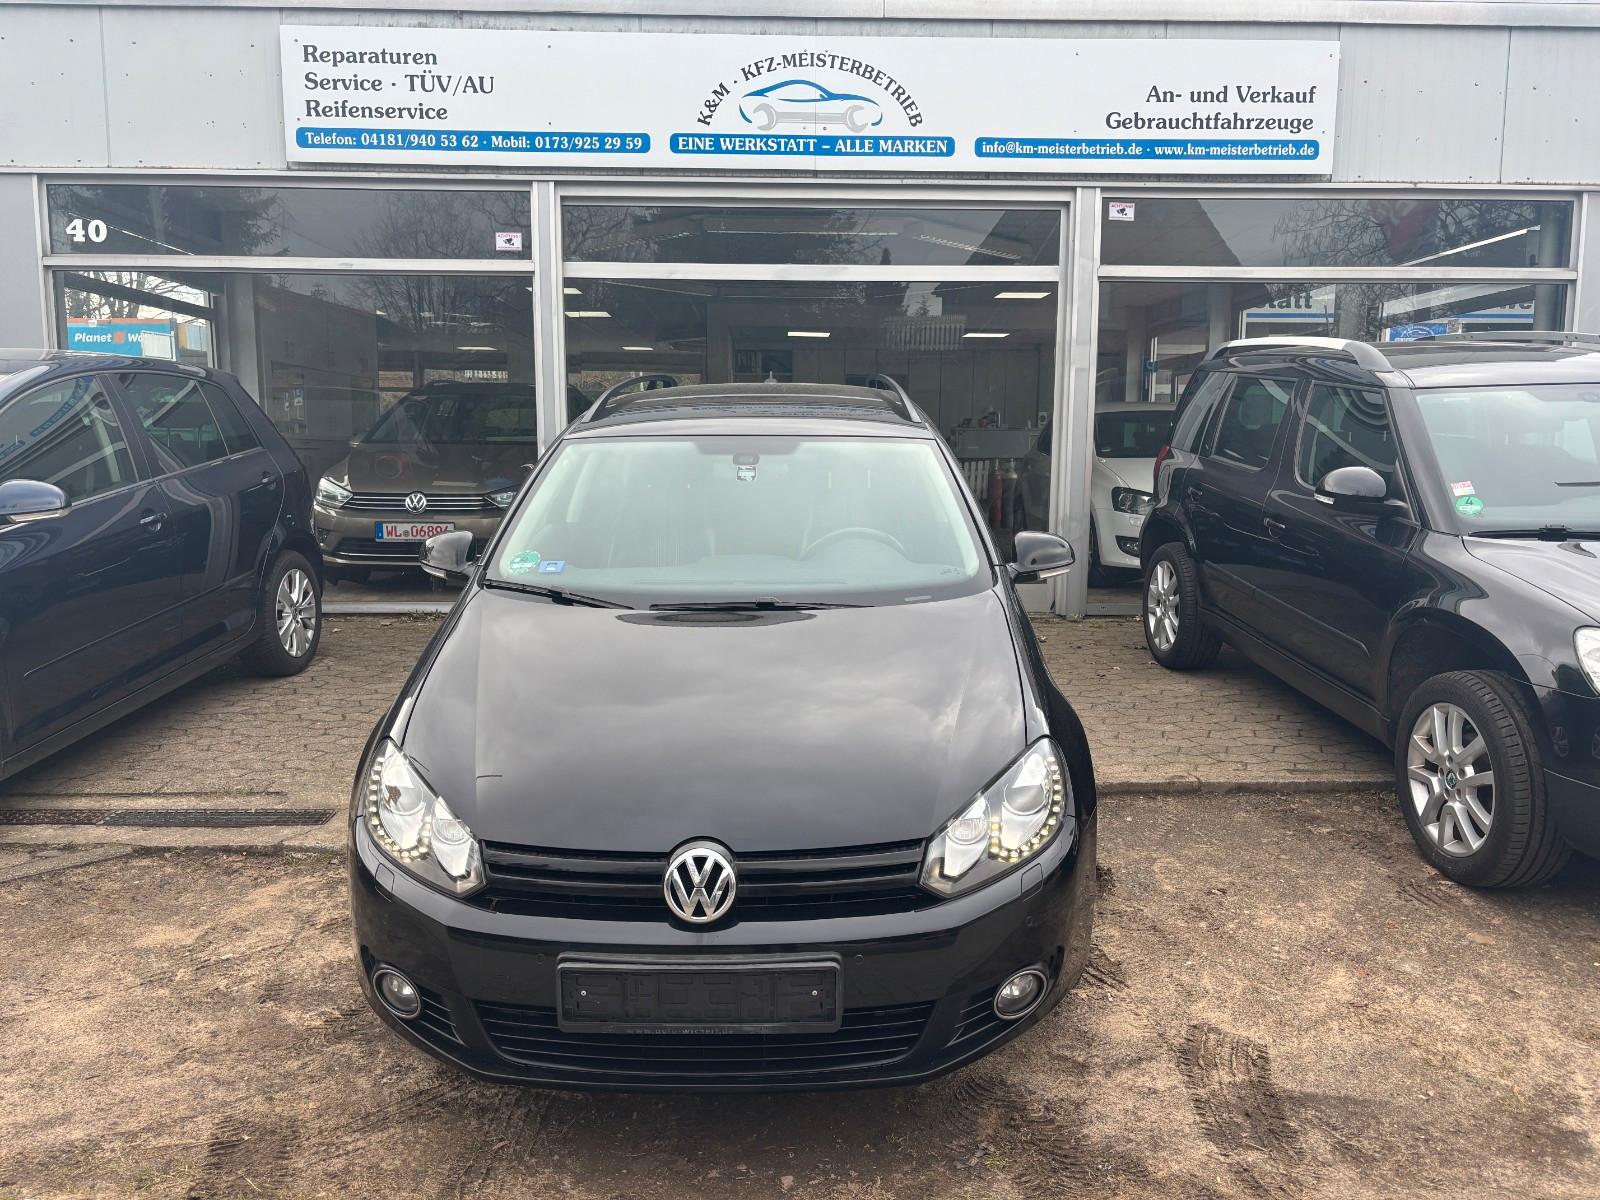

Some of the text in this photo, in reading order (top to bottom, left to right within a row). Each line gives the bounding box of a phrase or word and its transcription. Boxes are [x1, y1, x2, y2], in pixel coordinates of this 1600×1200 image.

[302, 44, 438, 66] Reparaturen
[304, 70, 495, 96] Service TÜV/AU
[696, 51, 923, 128] K&M KFZ-MEISTERBETRIEB
[1145, 84, 1317, 104] An- und Verkauf
[304, 99, 448, 120] Reifenservice
[1105, 111, 1314, 134] Gebrauchtfahrzeuge
[304, 132, 643, 151] Telefon: 04181/940 53 62 Mobil: 0173/925 29 59
[677, 137, 715, 151] EINE
[719, 138, 818, 152] WERKSTATT
[834, 139, 874, 153] ALLE
[878, 140, 948, 153] MARKEN
[981, 142, 1315, 156] info@km-meisterbetrieb.de www.km-meisterbetrieb.de
[65, 218, 108, 243] 40
[74, 332, 113, 343] Planet
[385, 525, 402, 538] WL
